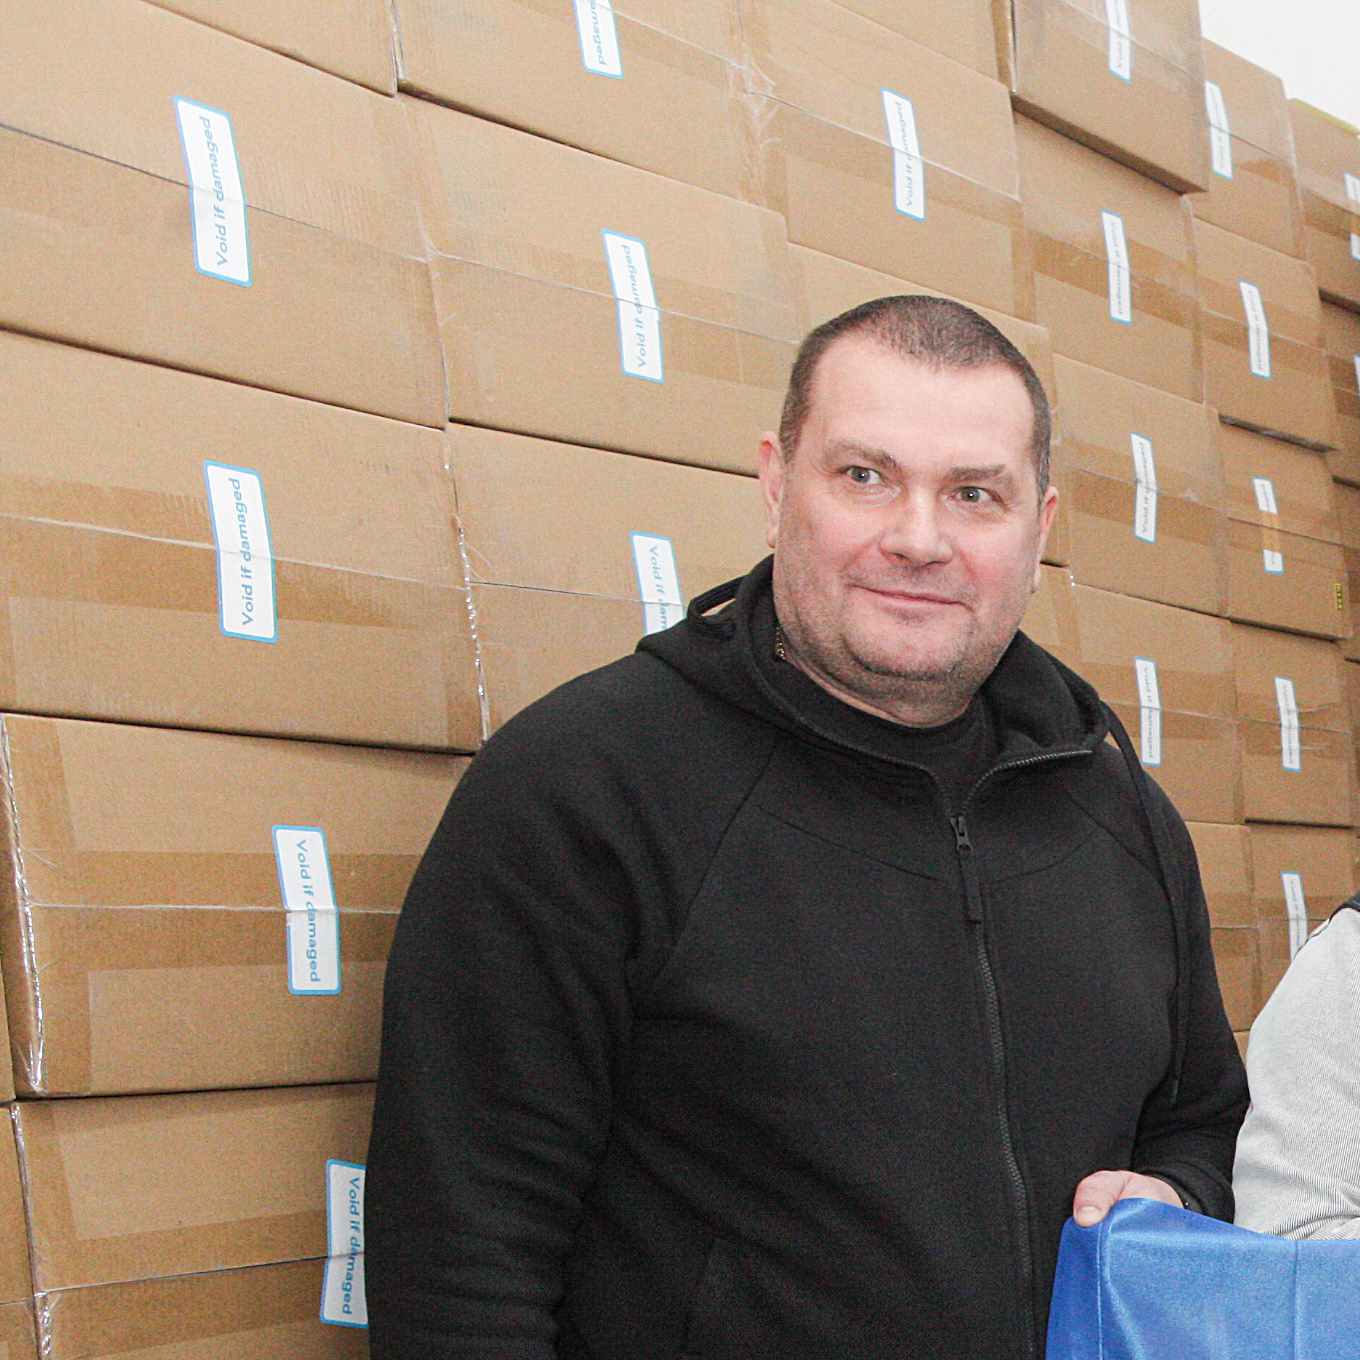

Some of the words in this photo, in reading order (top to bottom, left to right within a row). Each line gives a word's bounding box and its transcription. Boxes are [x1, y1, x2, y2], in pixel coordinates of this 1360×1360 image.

[198, 115, 226, 202] damaged
[213, 204, 227, 221] if
[216, 223, 229, 266] Void
[620, 244, 643, 314] damaged
[634, 318, 646, 331] if
[634, 333, 648, 367] Void
[228, 478, 252, 562] damaged
[239, 566, 252, 584] if
[649, 546, 662, 580] Void
[241, 586, 254, 625] Void
[655, 583, 665, 595] if
[295, 839, 312, 880] Void
[301, 883, 312, 900] if
[305, 901, 320, 982] damaged
[346, 1176, 361, 1216] Void
[348, 1218, 361, 1232] if
[340, 1235, 361, 1315] damaged
